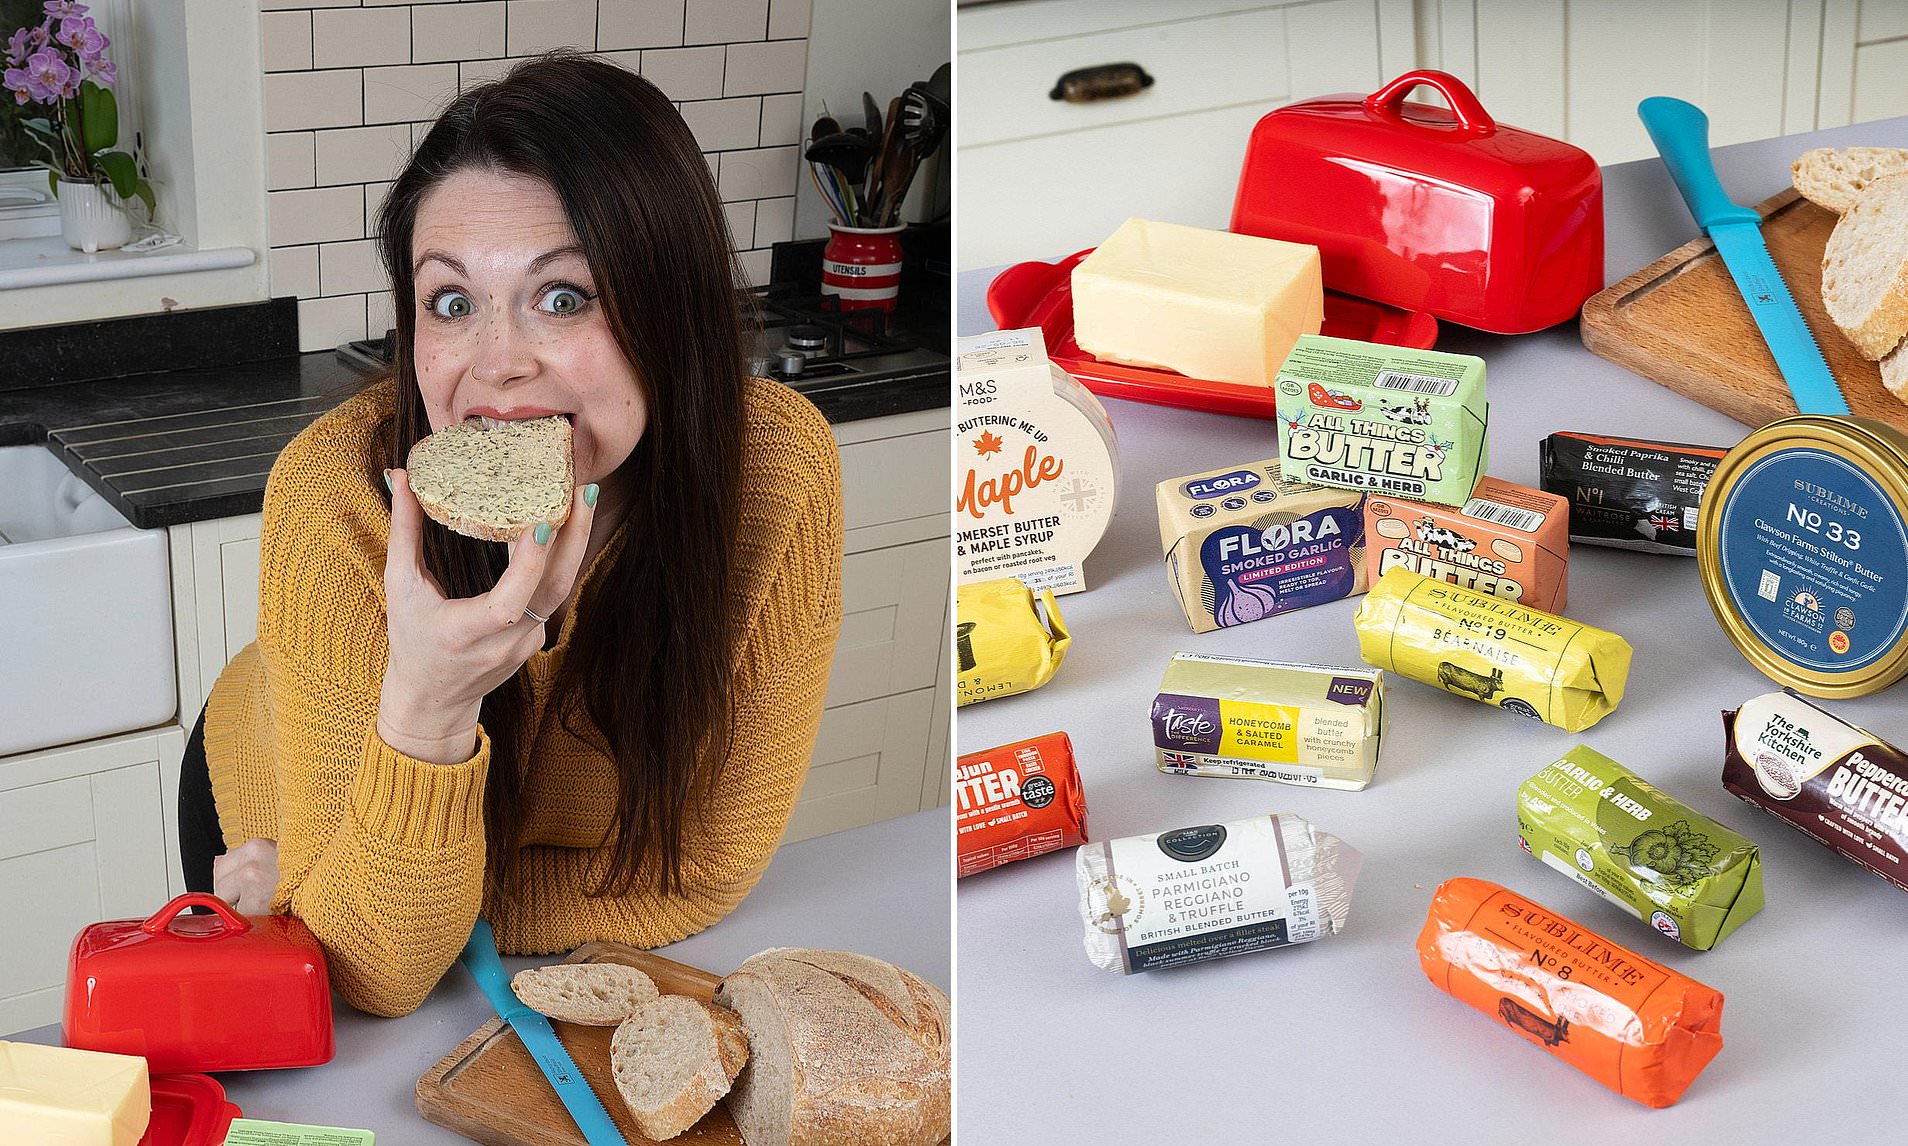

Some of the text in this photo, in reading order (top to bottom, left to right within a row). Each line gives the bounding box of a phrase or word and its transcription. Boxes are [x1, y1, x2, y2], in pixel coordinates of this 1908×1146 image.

[833, 264, 867, 276] UTENSILS
[960, 380, 997, 398] M&S
[958, 416, 1048, 443] BUTTERING ME UP
[1308, 414, 1426, 443] ALL THINGS
[1288, 430, 1446, 481] BUTTER
[1584, 452, 1624, 465] & Chilli
[1586, 444, 1670, 462] Smoked Paprika
[1680, 458, 1699, 466] Smoky
[1309, 468, 1365, 486] GARLIC
[1368, 476, 1380, 488] &
[1381, 479, 1423, 494] HERB
[1581, 461, 1660, 482] Blended Butter
[1189, 474, 1260, 496] FLORA
[1672, 484, 1688, 493] West
[1792, 479, 1869, 520] SUBLIME
[1810, 496, 1848, 517] CREATIONS
[1576, 507, 1630, 522] WAITROSE
[1655, 508, 1675, 516] CREAM
[1014, 516, 1061, 532] BUTTER
[958, 530, 1054, 556] & MAPLE SYRUP
[1220, 515, 1342, 562] FLORA
[1826, 522, 1862, 550] 33
[970, 548, 1044, 567] perfect with pancakes,
[1222, 538, 1342, 575] SMOKED GARLIC
[1398, 537, 1506, 576] ALL THINGS
[1754, 518, 1791, 542] Clawson
[1792, 534, 1820, 554] Farms
[1855, 563, 1884, 583] Butter
[973, 565, 993, 574] bacon
[1002, 558, 1028, 568] roasted
[1243, 558, 1324, 581] LIMITED EDITION
[1756, 534, 1769, 544] With
[1770, 540, 1782, 550] Beef
[1804, 556, 1820, 567] White
[1820, 562, 1838, 576] Truffle
[1844, 573, 1860, 585] Confit
[1860, 581, 1876, 592] Garlic
[1280, 582, 1298, 590] READY
[1304, 580, 1326, 588] SPREAD
[1379, 547, 1524, 604] BUTTER
[1427, 588, 1562, 636] SUBLIME
[1442, 602, 1533, 636] FLAVOURED BUTTER
[1785, 600, 1826, 623] CLAWSON
[1790, 610, 1816, 627] FARMS
[1485, 625, 1506, 640] 19
[1332, 684, 1368, 696] NEW
[1162, 708, 1216, 740] taste
[1229, 716, 1292, 732] HONEYCOMB
[1314, 717, 1349, 728] blended
[1318, 727, 1343, 738] butter
[1771, 714, 1794, 732] The
[1170, 734, 1210, 743] DIFFERENCE
[1236, 729, 1282, 740] & SALTED
[1236, 738, 1284, 749] CARAMEL
[1304, 736, 1356, 749] with crunchy
[1764, 722, 1822, 760] Yorkshire
[1306, 744, 1354, 756] honeycomb
[1317, 752, 1344, 764] pieces
[1758, 732, 1806, 765] Kitchen
[1204, 757, 1266, 769] Keep refrigerated
[1022, 784, 1054, 800] taste
[1028, 780, 1044, 790] great
[1538, 767, 1584, 800] BUTTER
[1552, 760, 1652, 822] GARLIC & HERB
[973, 810, 1028, 831] LOVE SMALL BATCH
[1166, 832, 1218, 844] COLLECTION
[1157, 860, 1240, 882] SMALL BATCH
[1576, 872, 1588, 884] Best
[1152, 872, 1250, 899] PARMIGIANO
[1298, 888, 1308, 896] 10g
[1164, 888, 1244, 910] REGGIANO
[1168, 901, 1244, 924] & TRUFFLE
[1140, 909, 1275, 940] BRITISH BLENDED BUTTER
[1136, 924, 1280, 957] Delicious melted over fillet steak
[1148, 954, 1170, 962] Made
[1171, 950, 1188, 958] with
[1190, 940, 1237, 954] Parmigiano
[1500, 902, 1644, 987] SUBLIME
[1512, 924, 1610, 984] FLAVOURED BUTTER
[1557, 965, 1572, 980] 8
